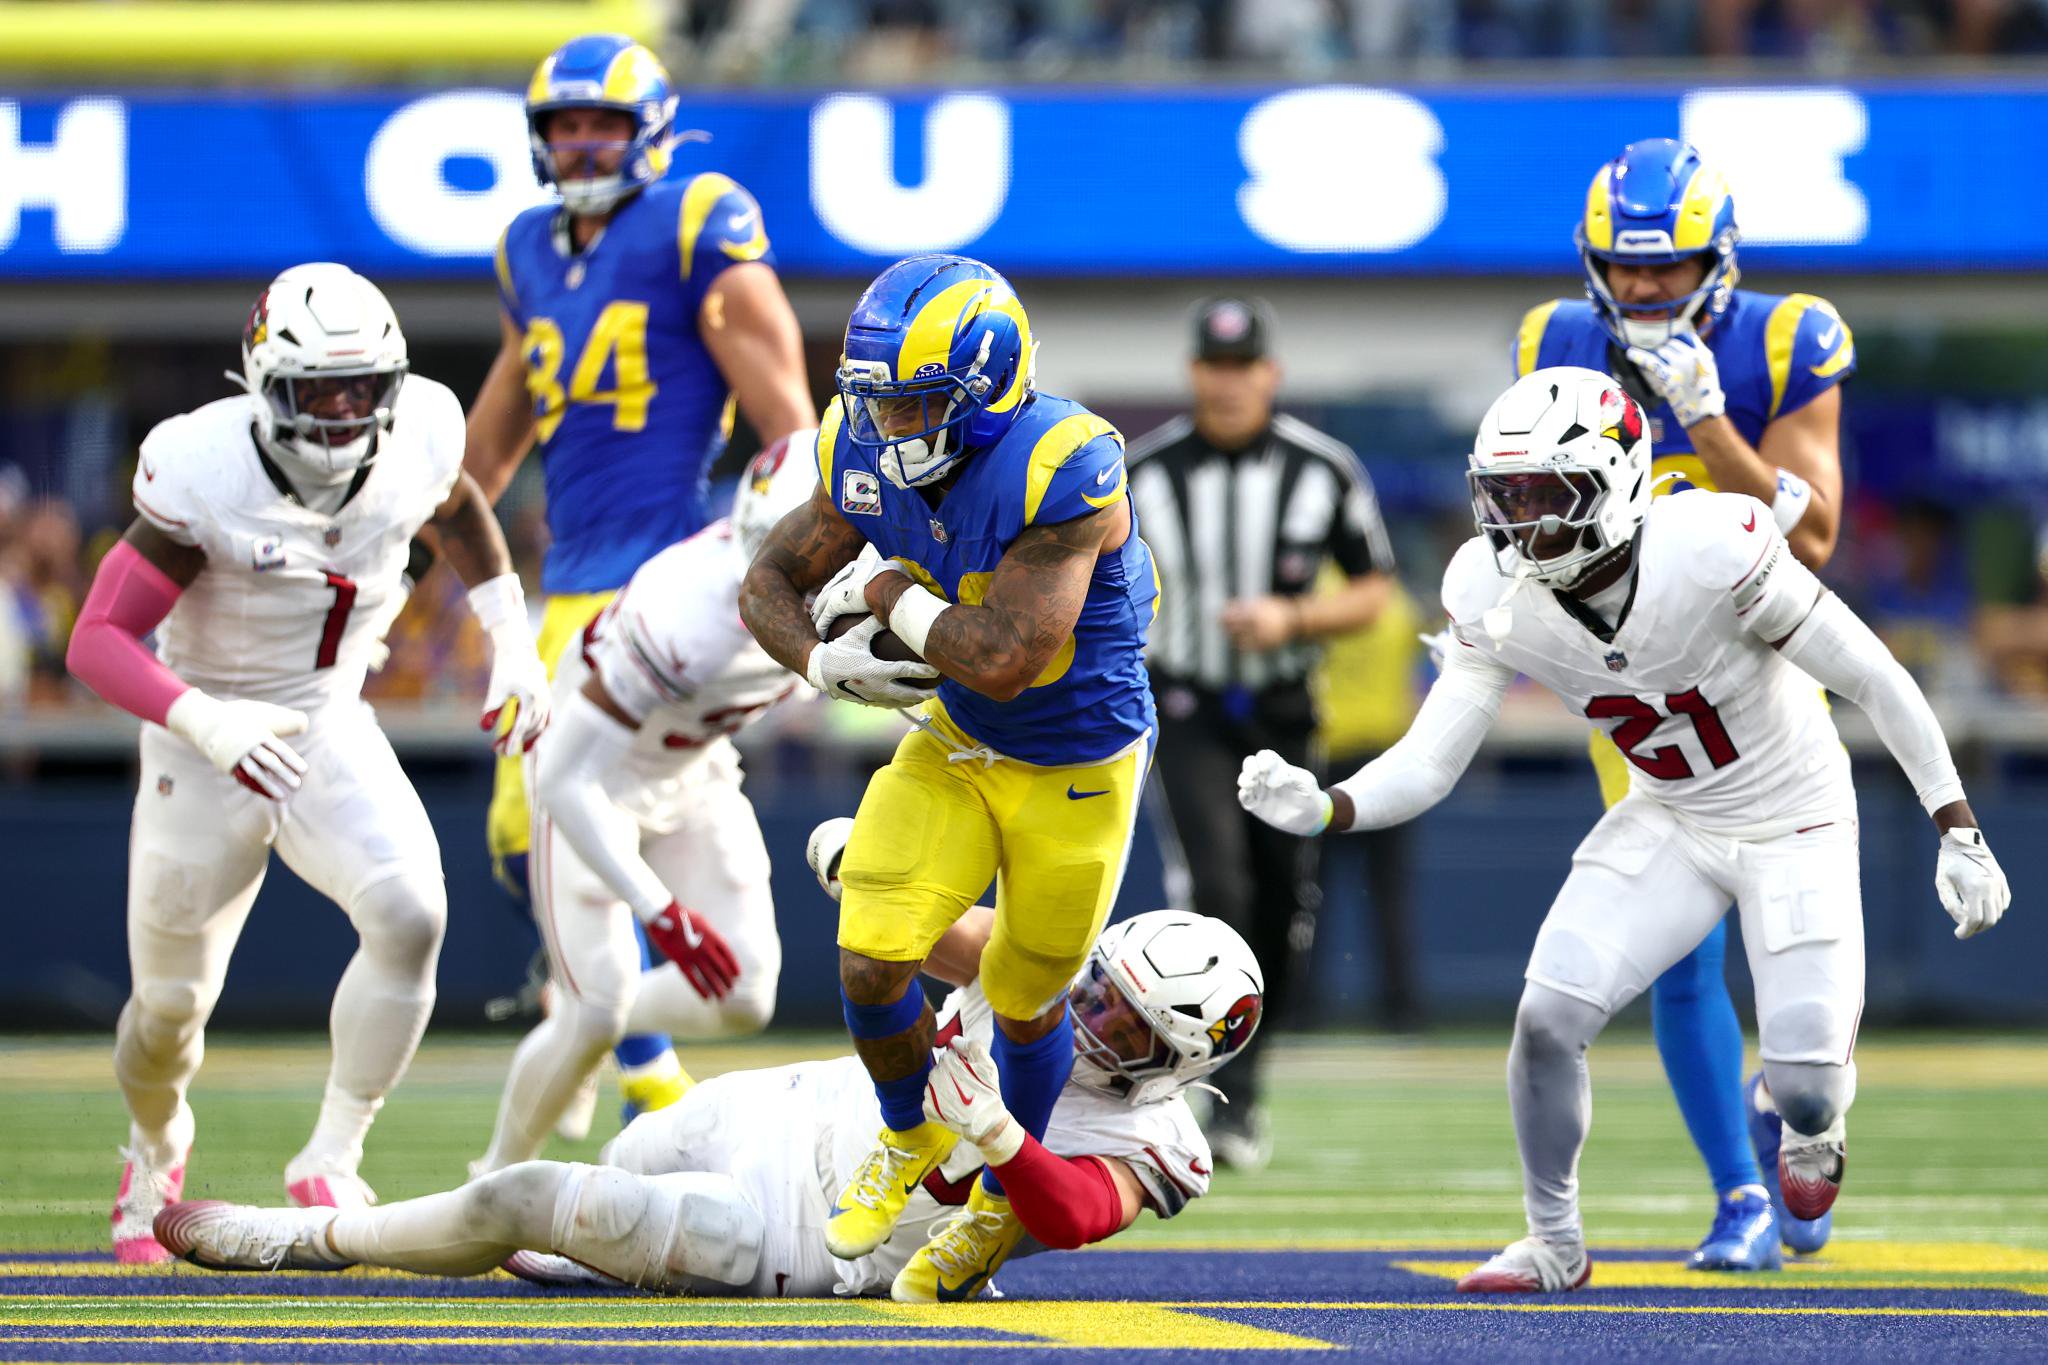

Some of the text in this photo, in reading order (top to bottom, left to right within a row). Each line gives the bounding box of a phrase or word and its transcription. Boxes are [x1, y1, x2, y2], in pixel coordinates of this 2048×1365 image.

[0, 88, 1870, 257] HOUSE
[519, 299, 660, 446] 84
[314, 568, 357, 671] 1
[1583, 685, 1741, 781] 21
